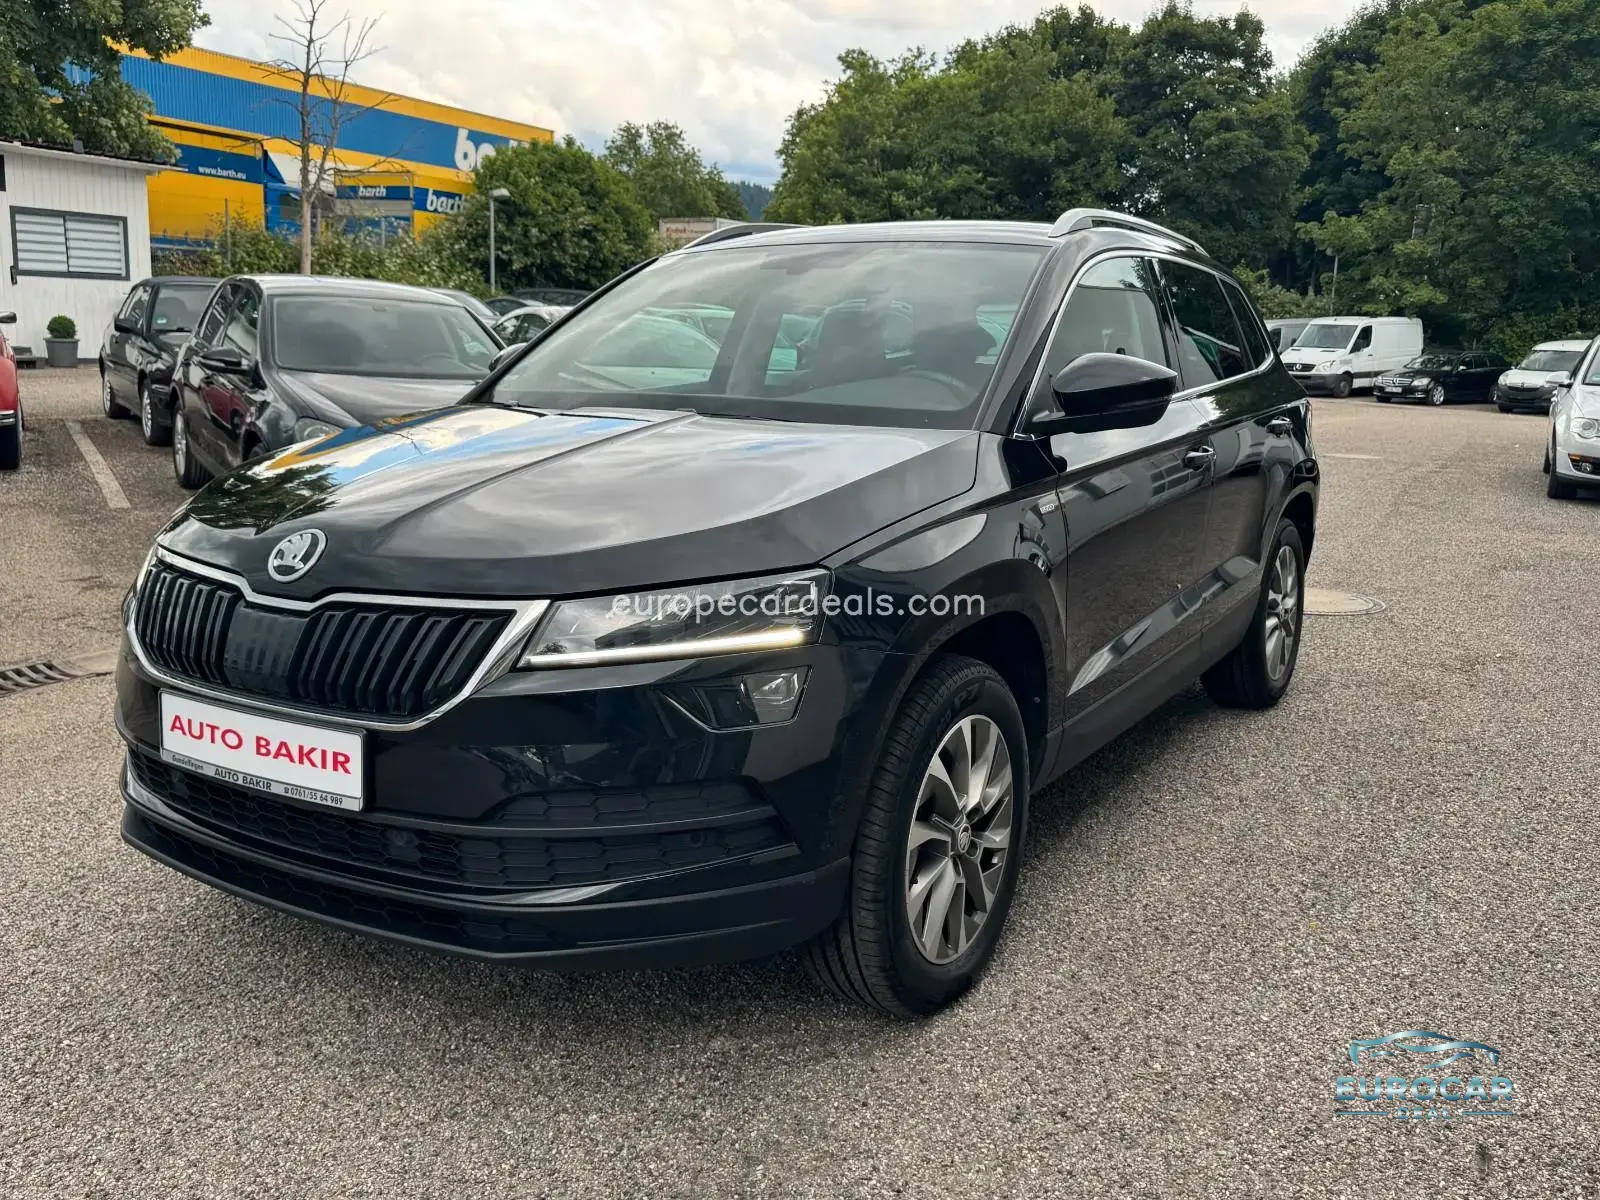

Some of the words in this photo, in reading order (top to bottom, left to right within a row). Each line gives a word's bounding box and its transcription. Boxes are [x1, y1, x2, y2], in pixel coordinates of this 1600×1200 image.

[198, 166, 247, 180] www.barth.eu
[359, 185, 386, 197] barth
[169, 714, 243, 750] AUTO
[255, 735, 351, 775] BAKIR
[214, 768, 239, 782] AUTO
[242, 775, 272, 791] BAKIR
